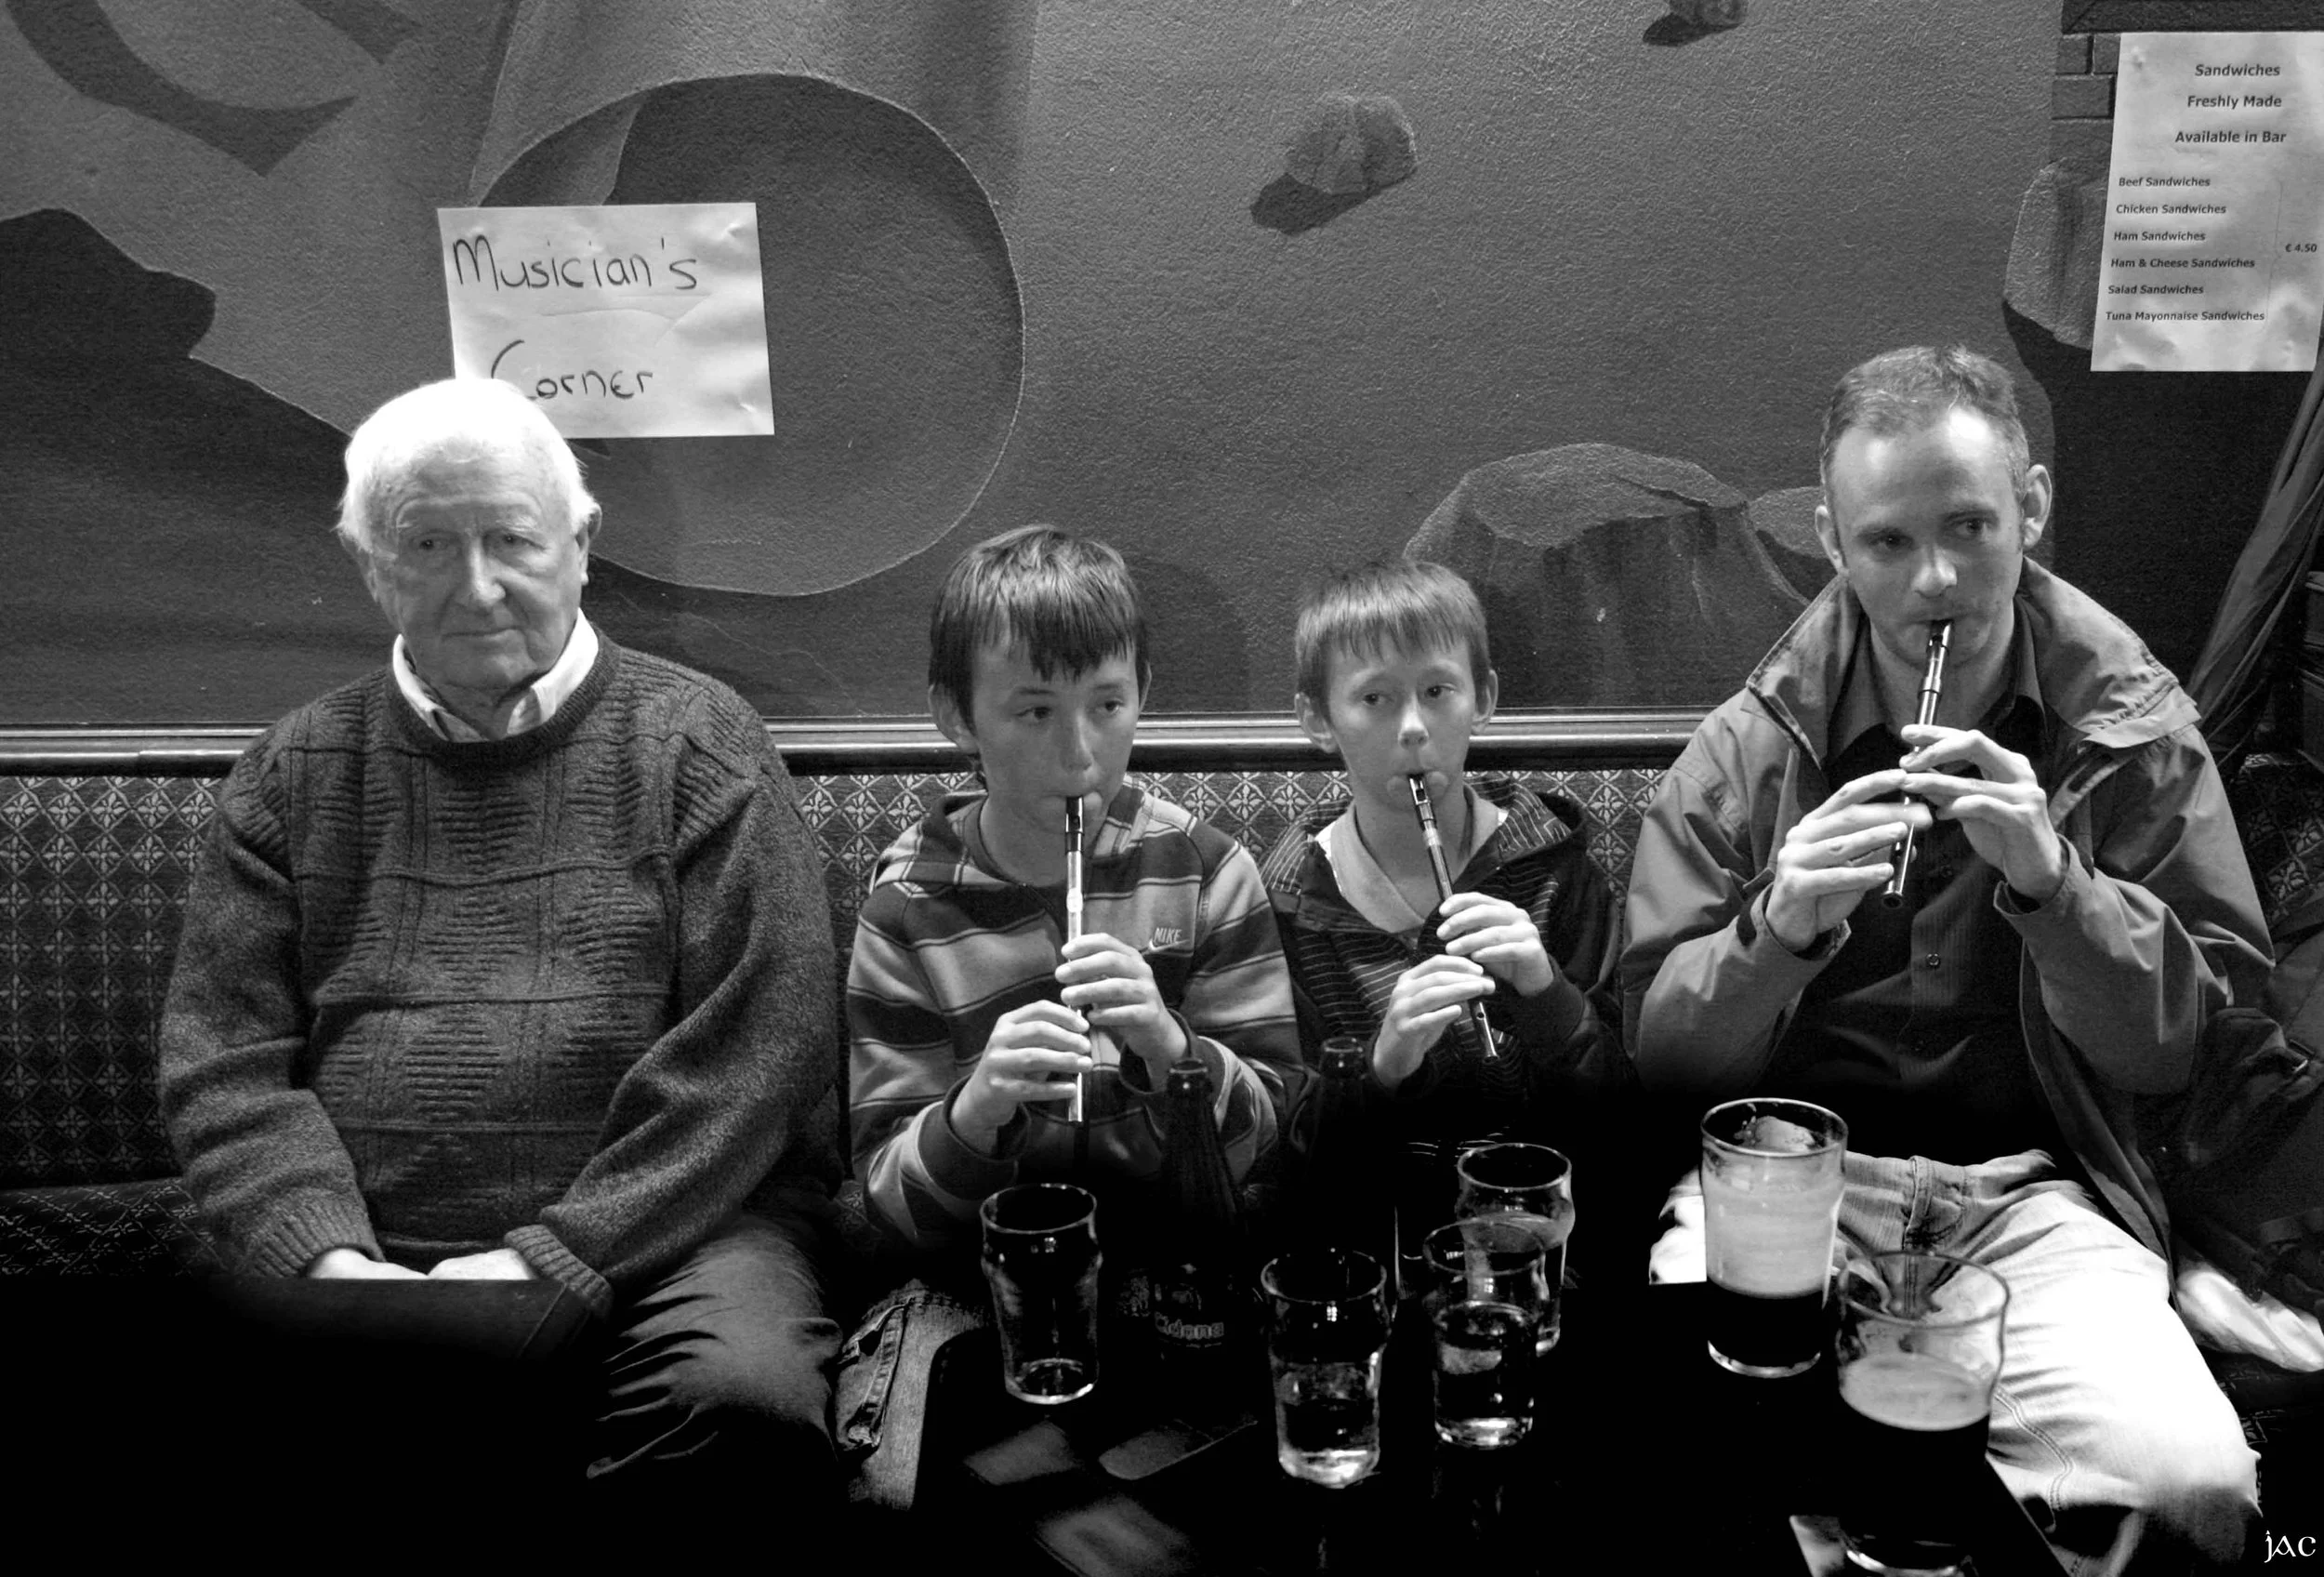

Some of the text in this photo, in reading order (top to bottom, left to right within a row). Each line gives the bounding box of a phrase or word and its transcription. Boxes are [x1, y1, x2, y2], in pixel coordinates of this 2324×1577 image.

[2195, 63, 2281, 77] Sandwiches
[2187, 95, 2283, 110] Freshly Made
[2175, 130, 2288, 143] Available in Bar
[2119, 177, 2211, 187] Beef Sandwiches
[2116, 204, 2226, 214] Chicken Sandwiches
[2113, 231, 2206, 241] Ham Sandwiches
[2285, 243, 2317, 253] € 4.50
[453, 234, 698, 291] Musician's
[2110, 258, 2255, 268] Ham & Cheese Sandwiches
[2108, 285, 2204, 294] Salad Sandwiches
[2106, 311, 2265, 323] Tuna Mayonnaise Sandwiches
[1154, 927, 1182, 944] NIKE
